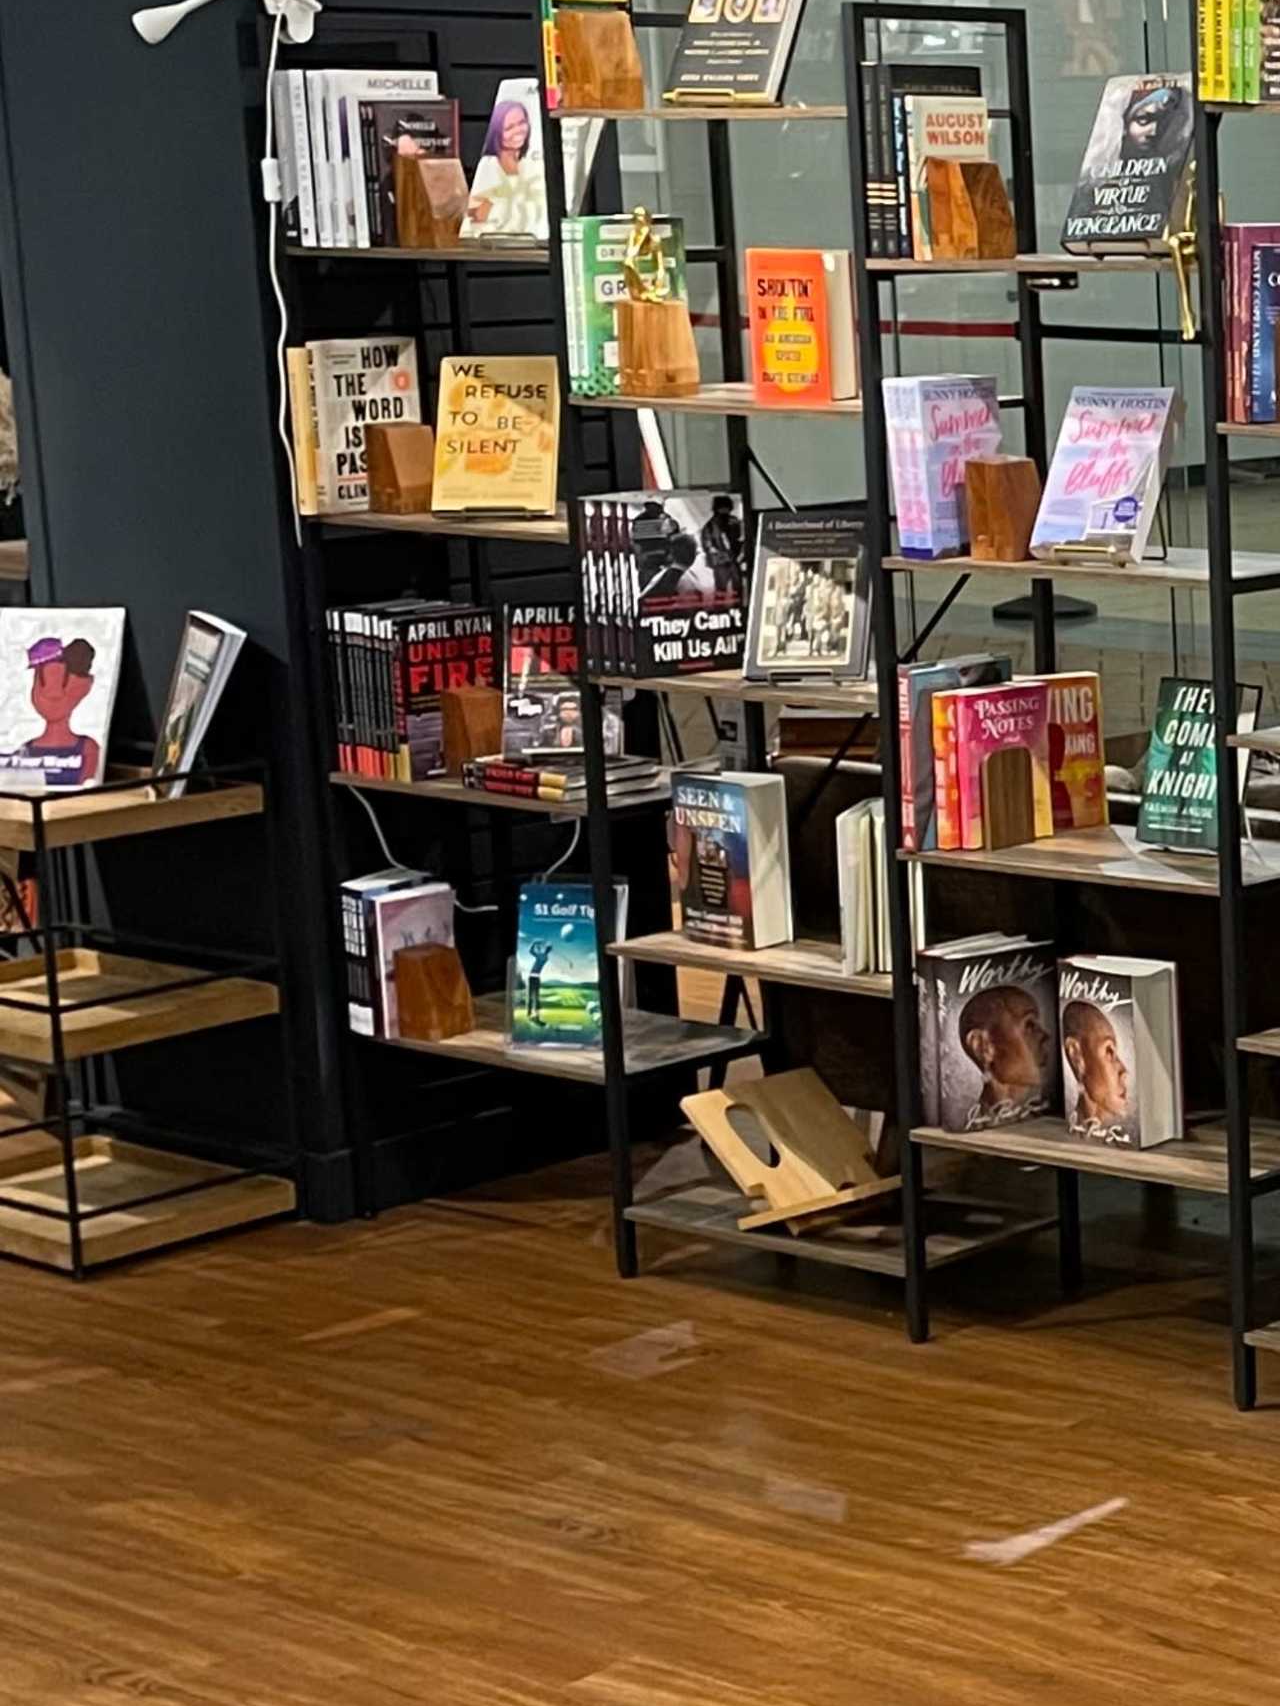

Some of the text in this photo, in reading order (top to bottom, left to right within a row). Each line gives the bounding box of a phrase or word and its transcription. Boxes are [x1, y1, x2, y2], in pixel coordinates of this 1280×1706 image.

[367, 78, 432, 91] MICHELLE
[926, 113, 984, 129] AUGUST
[927, 130, 985, 147] WILSON
[1090, 157, 1168, 179] CHILDREN
[1093, 184, 1149, 206] VIRTUE
[1066, 214, 1161, 237] VENGEANCE
[361, 344, 400, 369] HOW
[452, 364, 486, 379] WE
[334, 373, 367, 397] THE
[465, 384, 549, 400] REFUSE
[352, 397, 404, 422] WORD
[1074, 396, 1168, 411] SUNNY HOSTIN
[449, 410, 523, 431] TO BE
[345, 425, 364, 450] IS
[446, 439, 522, 455] SILENT
[337, 452, 368, 476] PAS
[338, 484, 368, 500] CLIN
[775, 520, 821, 531] Brotherhood
[822, 519, 834, 530] of
[835, 519, 865, 532] Liberty
[511, 605, 560, 626] APRIL
[694, 608, 742, 631] Can't
[407, 615, 493, 643] APRIL RYAN
[511, 625, 573, 644] UND
[409, 636, 493, 664] UNDER
[511, 646, 578, 675] FIR
[653, 640, 684, 663] Kill
[687, 638, 712, 659] Us
[409, 657, 494, 694] FIRE
[974, 697, 1041, 720] PASSING
[1048, 686, 1095, 725] ING
[981, 715, 1035, 740] NOTES
[1179, 751, 1195, 766] AT
[676, 785, 735, 811] SEEN &
[675, 806, 741, 834] UNSEEN
[551, 903, 577, 917] Golf
[580, 904, 595, 920] Tip
[958, 954, 1054, 995] Worthy
[1059, 970, 1134, 1012] Worthy
